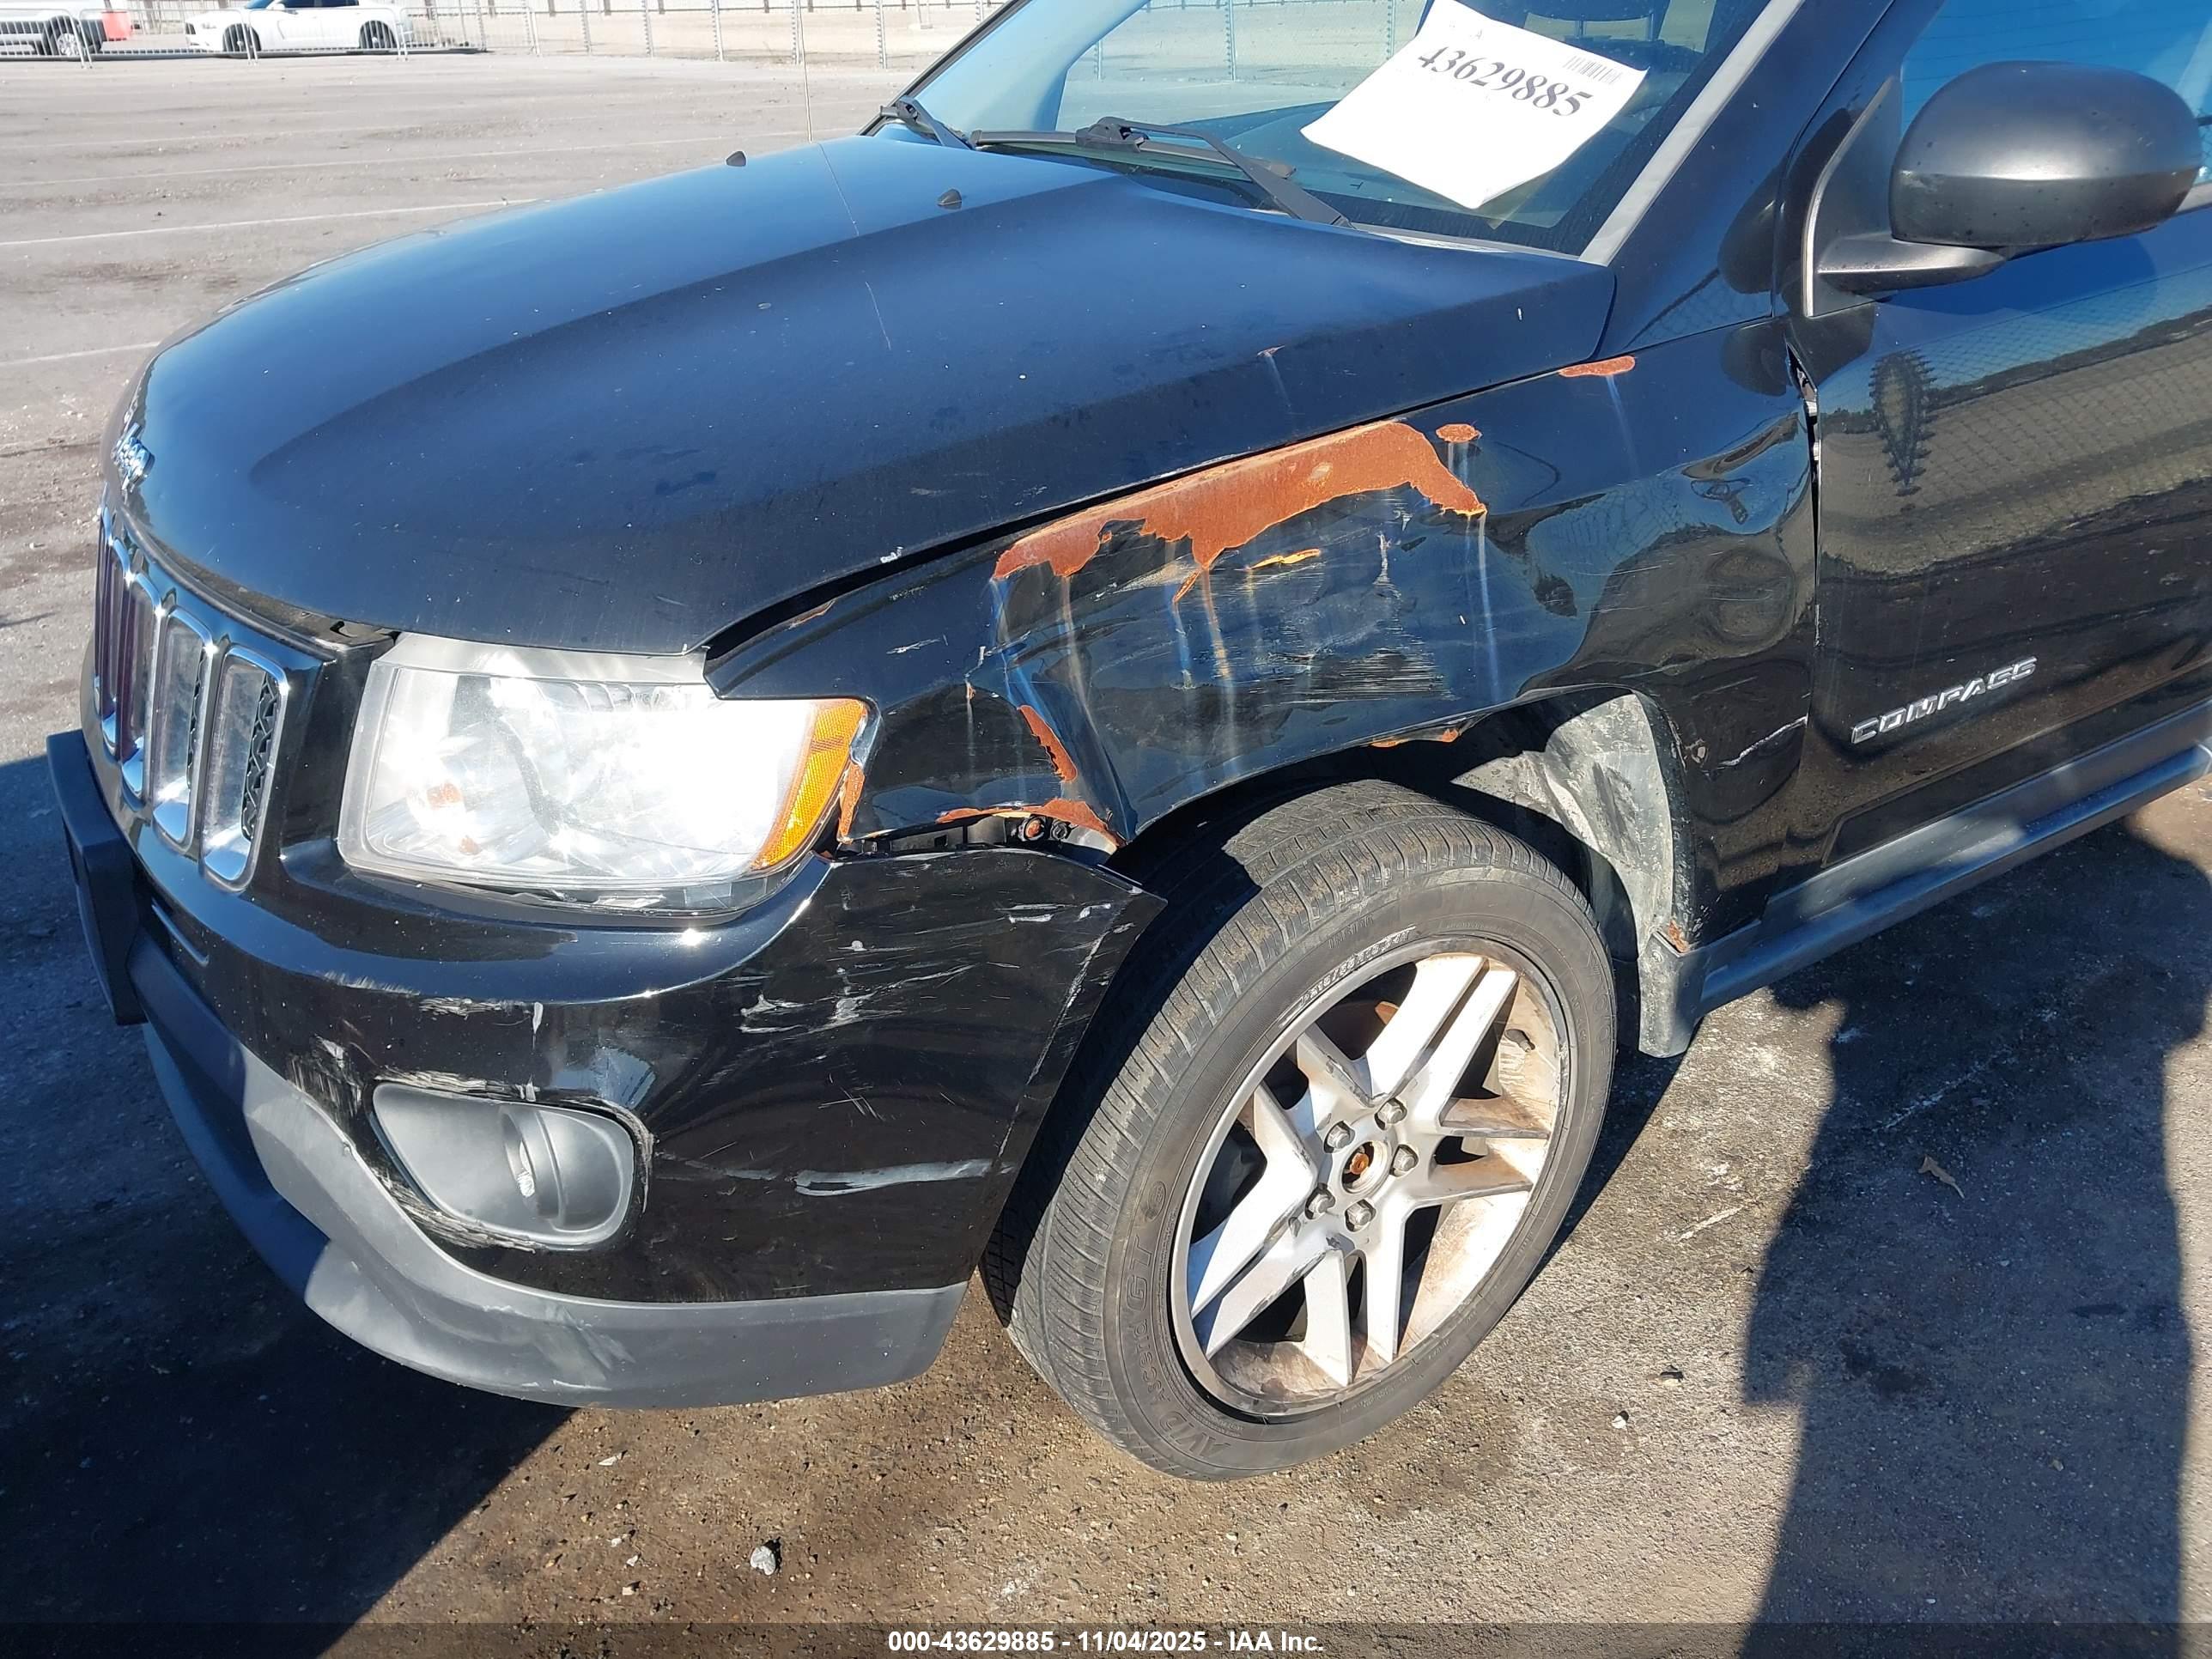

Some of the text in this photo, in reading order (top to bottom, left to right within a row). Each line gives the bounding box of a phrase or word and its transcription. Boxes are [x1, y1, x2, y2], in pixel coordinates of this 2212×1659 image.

[1417, 46, 1595, 117] 43629885
[1850, 655, 2039, 744] COMPASS
[1125, 1234, 1152, 1313] GT
